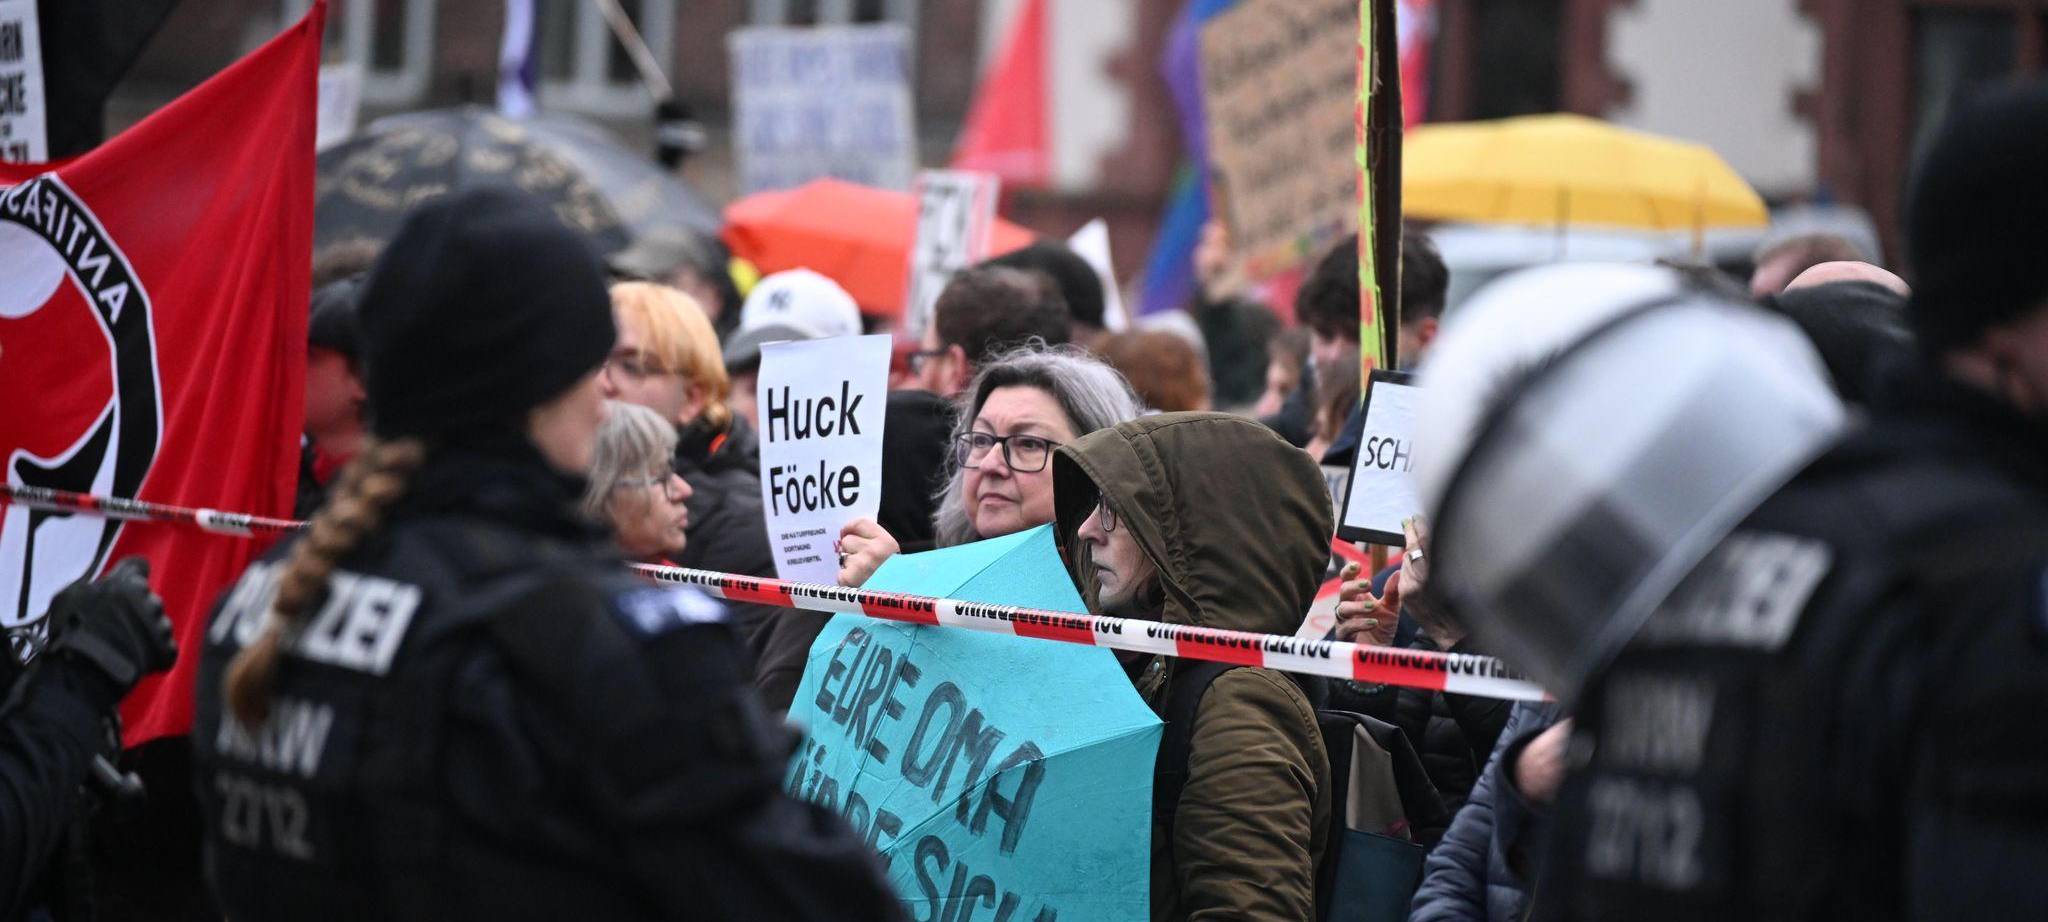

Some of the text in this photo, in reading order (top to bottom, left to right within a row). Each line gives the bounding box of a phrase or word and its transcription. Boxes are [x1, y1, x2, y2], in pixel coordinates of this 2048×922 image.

[767, 380, 864, 443] Huck
[1363, 435, 1415, 473] SCH
[769, 459, 861, 517] Föcke
[814, 626, 1047, 858] EURE OMA
